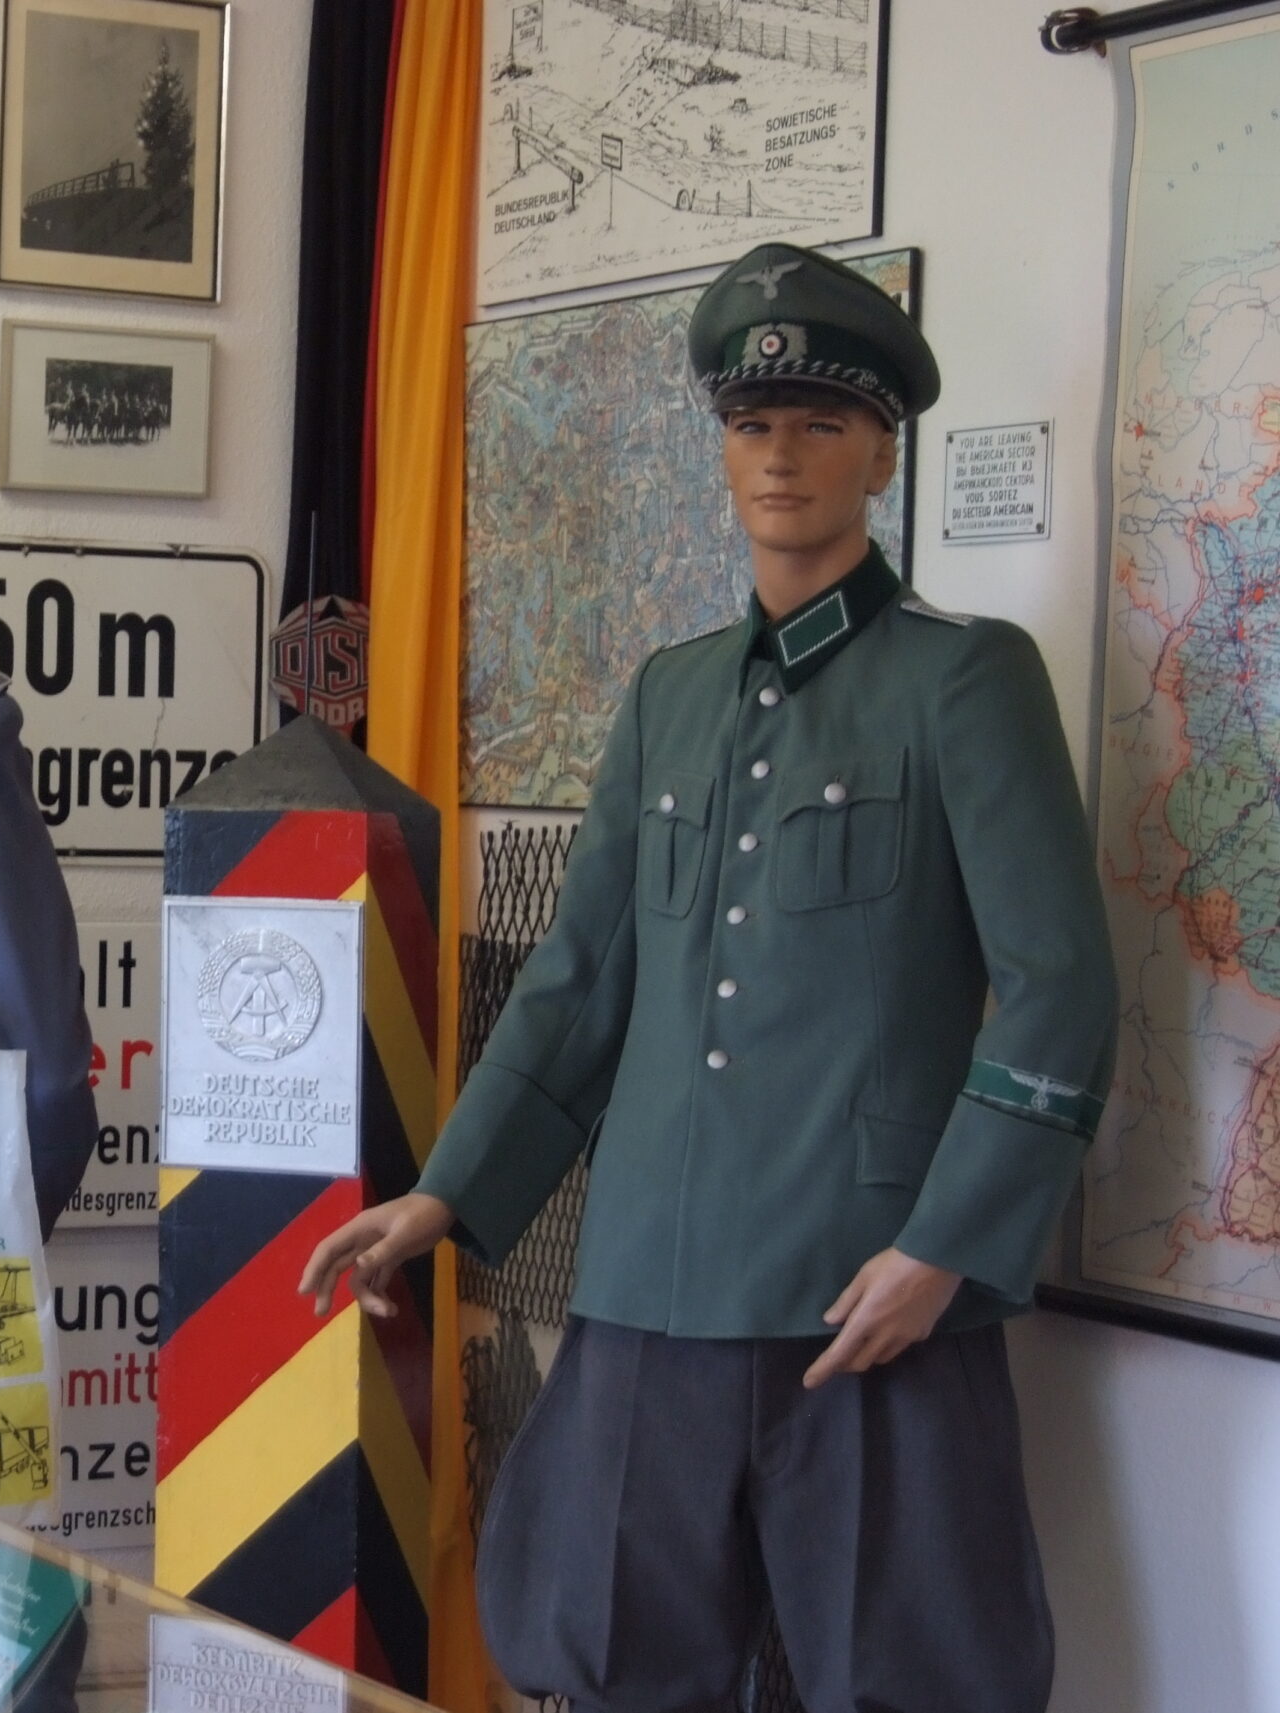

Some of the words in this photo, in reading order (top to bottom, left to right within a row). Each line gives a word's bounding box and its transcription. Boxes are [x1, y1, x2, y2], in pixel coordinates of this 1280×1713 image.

[766, 103, 837, 133] SOWJETISCHE
[765, 124, 840, 152] BESATZUNGS-
[765, 153, 794, 172] ZONE
[494, 189, 569, 217] BUNDESREPUBLIK
[494, 210, 556, 235] DEUTSCHLAND
[959, 437, 975, 449] YOU
[978, 435, 994, 447] ARE
[997, 431, 1032, 446] LEAVING
[955, 452, 967, 464] THE
[969, 448, 1005, 462] AMERICAN
[1007, 446, 1036, 460] SECTOR
[965, 491, 985, 504] VOUS
[988, 489, 1018, 502] SORTEZ
[952, 508, 962, 520] DU
[962, 506, 992, 519] SECTEUR
[97, 611, 177, 699] m
[280, 630, 369, 694] DTS
[23, 746, 239, 827] grenz
[204, 1072, 319, 1100] DEUTSCHE
[169, 1095, 352, 1126] DEMOKRATISCHE
[97, 1124, 160, 1165] en
[204, 1119, 318, 1148] REPUBLIK
[65, 1185, 158, 1218] desgrenz
[61, 1351, 159, 1408] mitt
[25, 1500, 157, 1538] grenzsch
